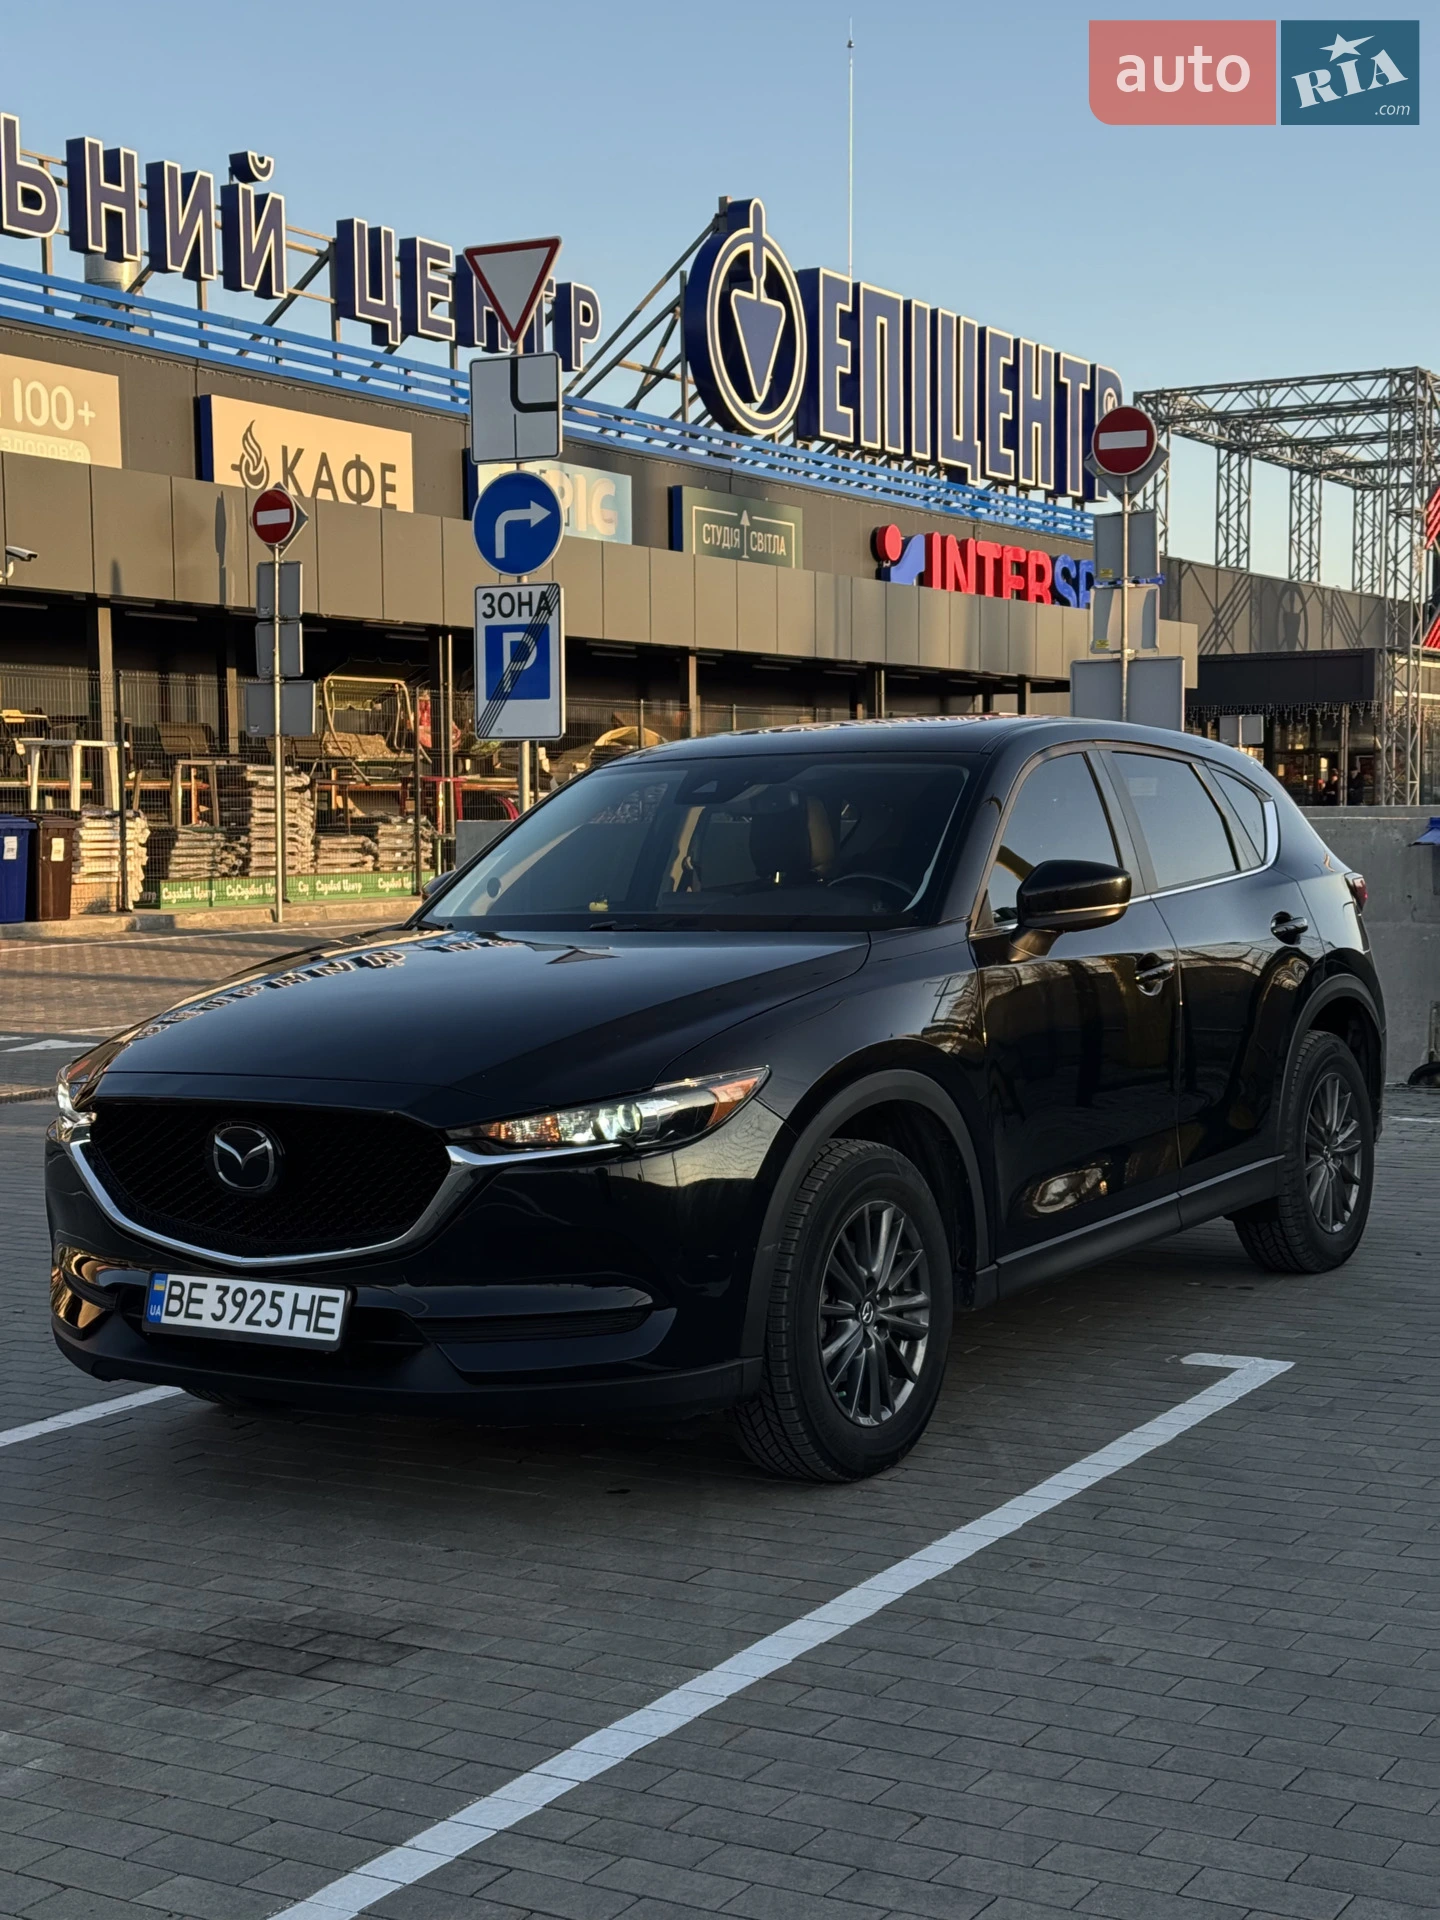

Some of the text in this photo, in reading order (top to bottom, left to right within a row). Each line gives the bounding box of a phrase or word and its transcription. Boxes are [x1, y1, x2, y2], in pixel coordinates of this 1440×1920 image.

[13, 377, 96, 431] 100+
[281, 445, 397, 510] КАФЕ
[702, 523, 787, 556] СТУДІЯ СВІТЛА
[482, 591, 552, 619] ЗОНА
[150, 1306, 161, 1316] UA
[164, 1280, 340, 1335] BE 3925 HE
